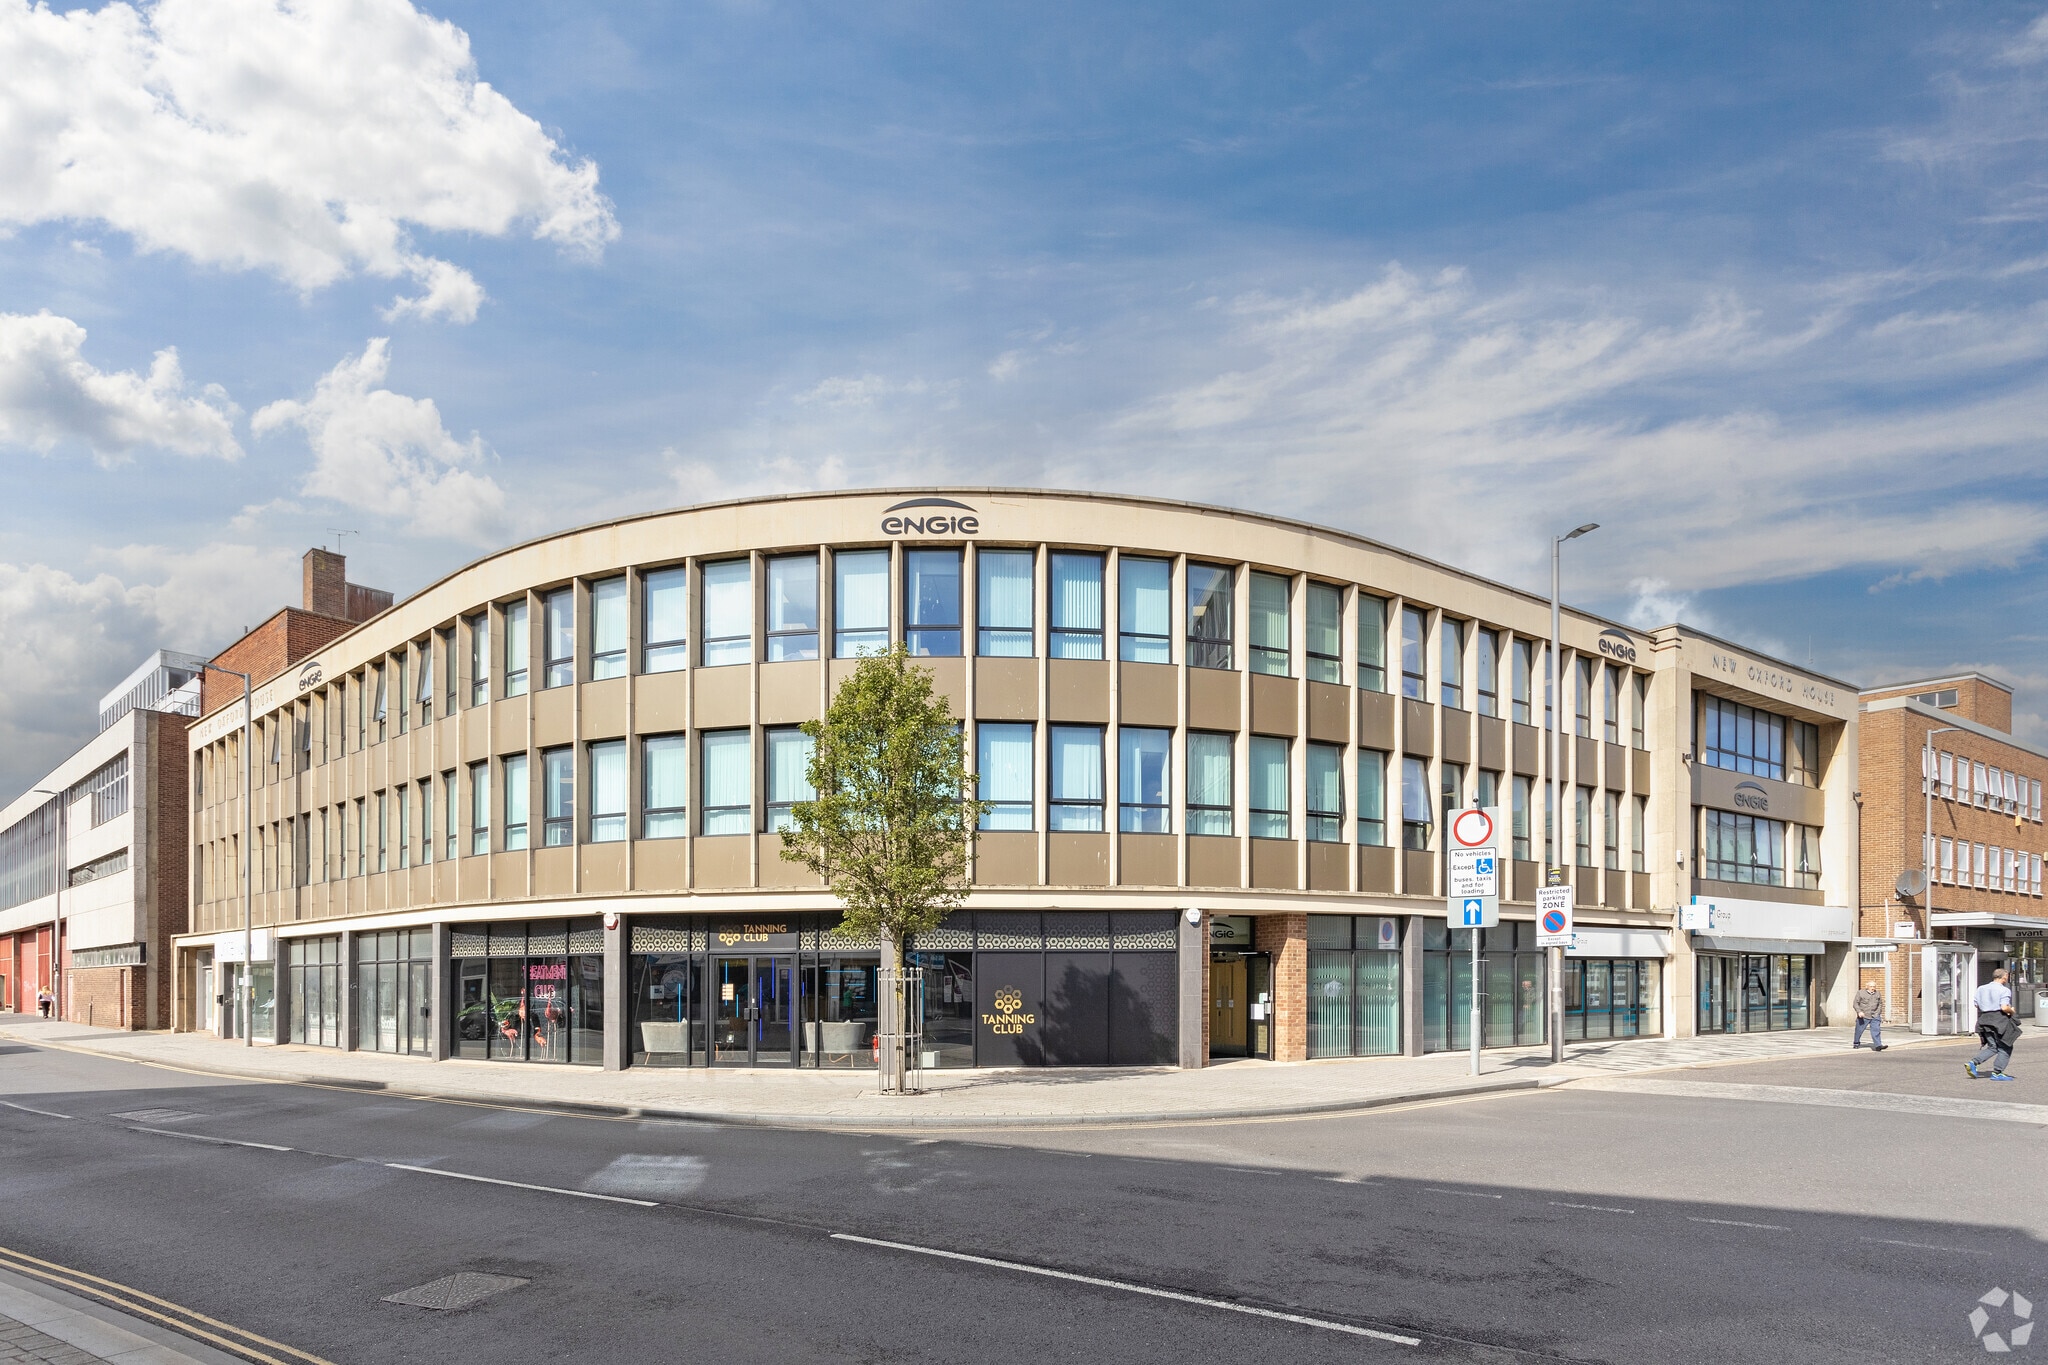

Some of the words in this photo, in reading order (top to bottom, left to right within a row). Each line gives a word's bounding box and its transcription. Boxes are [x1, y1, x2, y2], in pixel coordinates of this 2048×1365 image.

[1712, 653, 1736, 674] NEW
[1747, 665, 1792, 694] OXFORD
[1802, 684, 1835, 708] HOUSE
[1542, 901, 1566, 909] ZONE
[743, 924, 787, 933] TANNING
[743, 933, 769, 942] CLUB
[522, 965, 567, 980] TEATMENT
[982, 1014, 1035, 1025] TANNING
[993, 1024, 1024, 1034] CLUB
